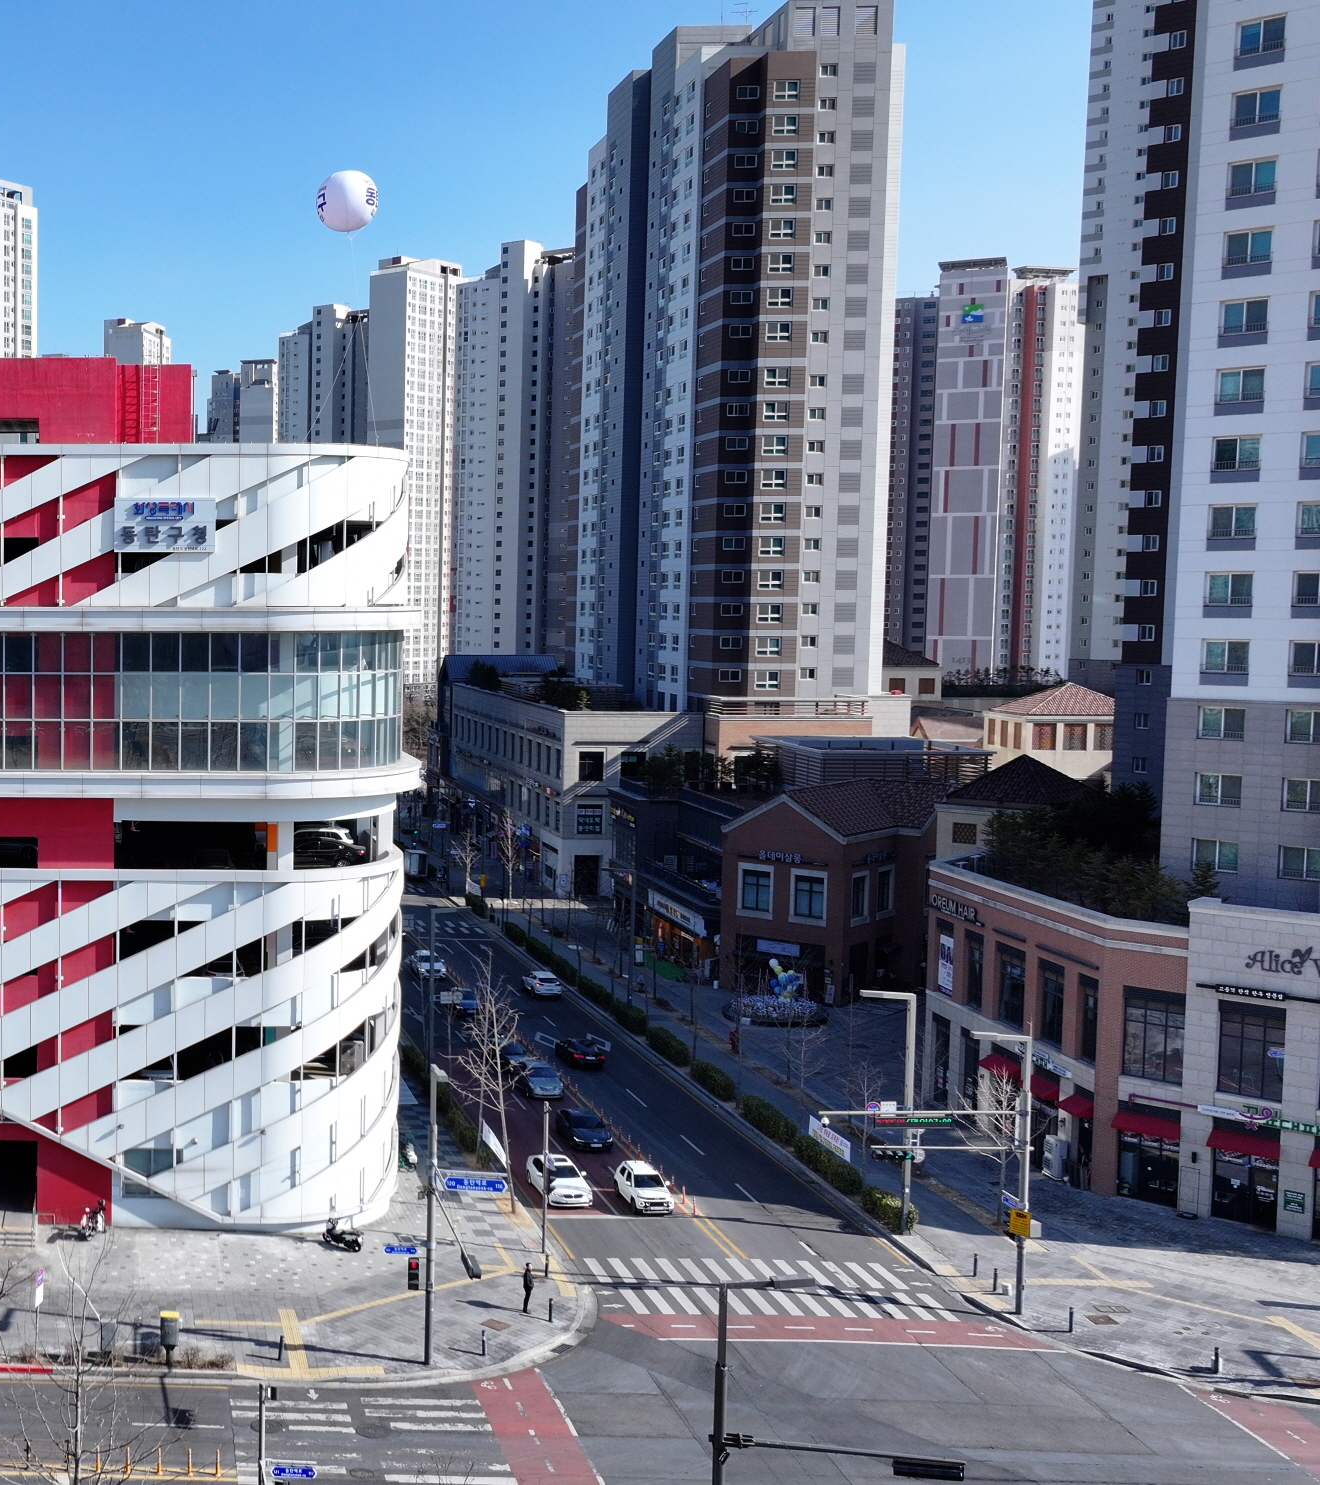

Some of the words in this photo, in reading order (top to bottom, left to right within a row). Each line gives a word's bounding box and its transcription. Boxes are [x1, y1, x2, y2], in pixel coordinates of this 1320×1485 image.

[133, 501, 195, 515] 화성특례시
[120, 525, 207, 545] 동탄구청
[758, 849, 802, 865] 올데이살롱
[932, 894, 957, 914] OREUM
[958, 902, 976, 921] HAIR
[1245, 950, 1305, 975] Alice
